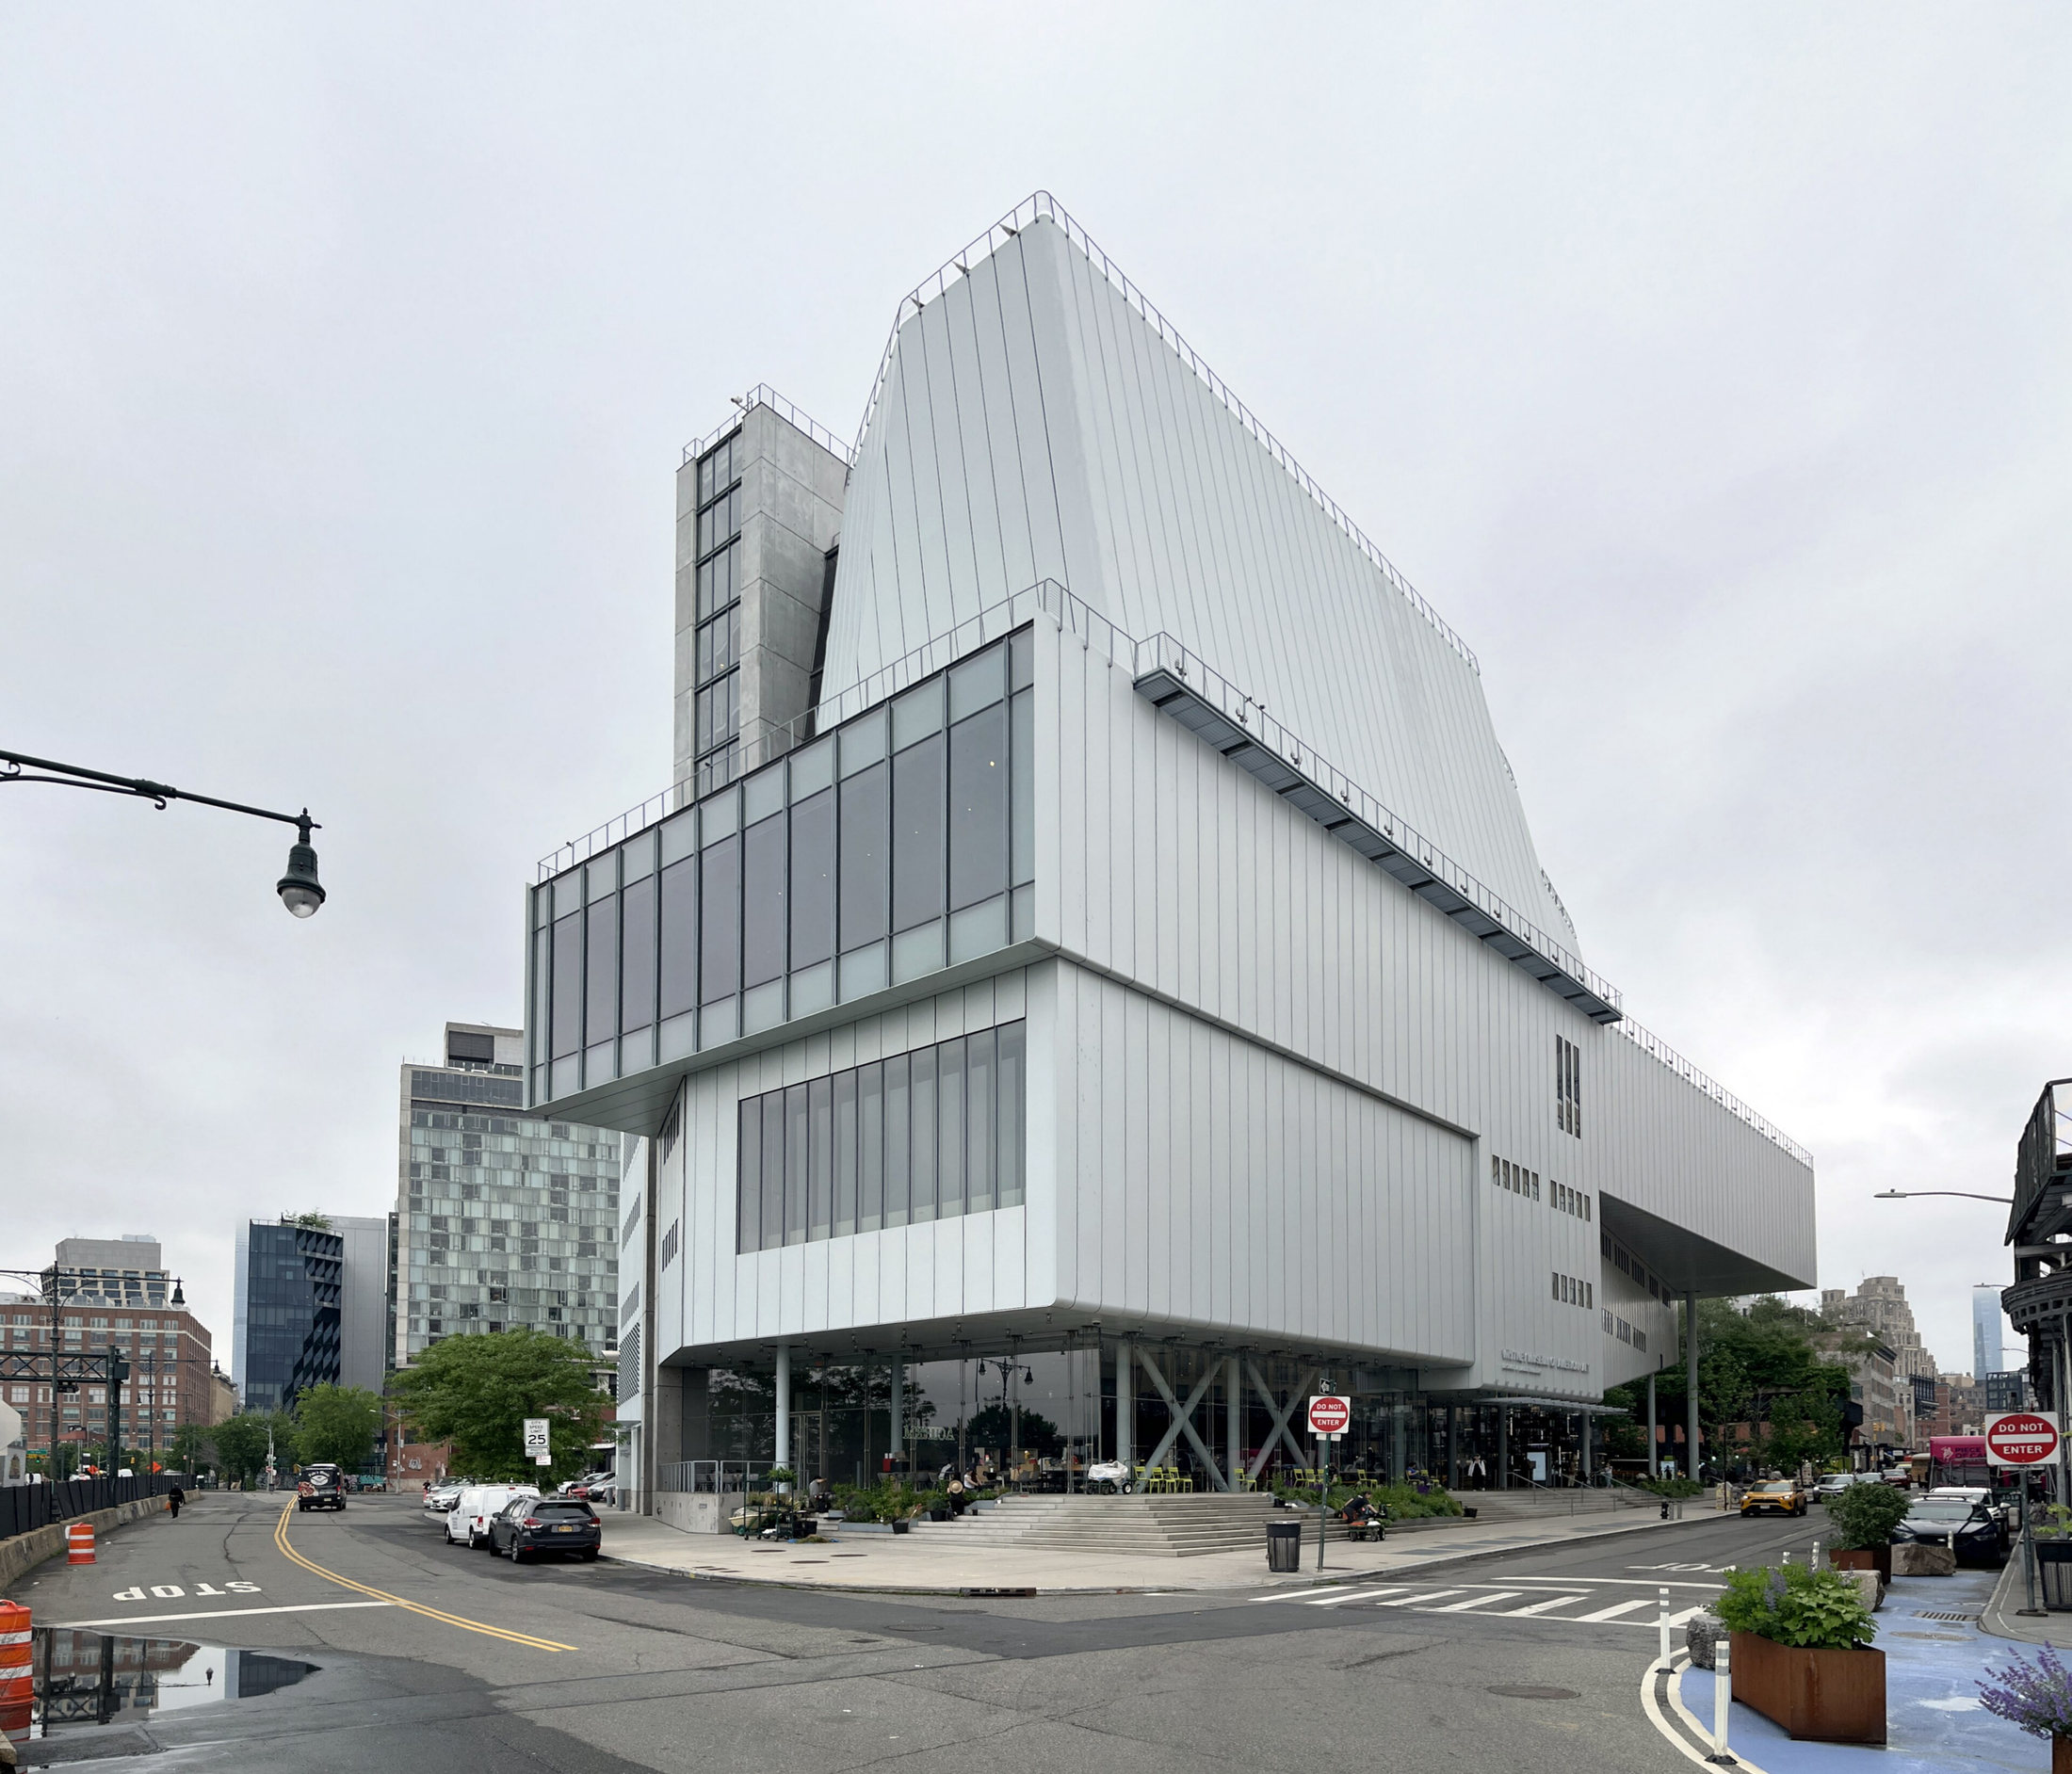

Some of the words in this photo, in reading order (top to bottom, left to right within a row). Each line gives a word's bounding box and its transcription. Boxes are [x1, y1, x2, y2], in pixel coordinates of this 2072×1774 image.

[1999, 1424, 2015, 1432] DO
[2019, 1423, 2044, 1431] NOT
[528, 1434, 546, 1444] 25
[2002, 1444, 2043, 1455] ENTER
[112, 1581, 262, 1602] STOP
